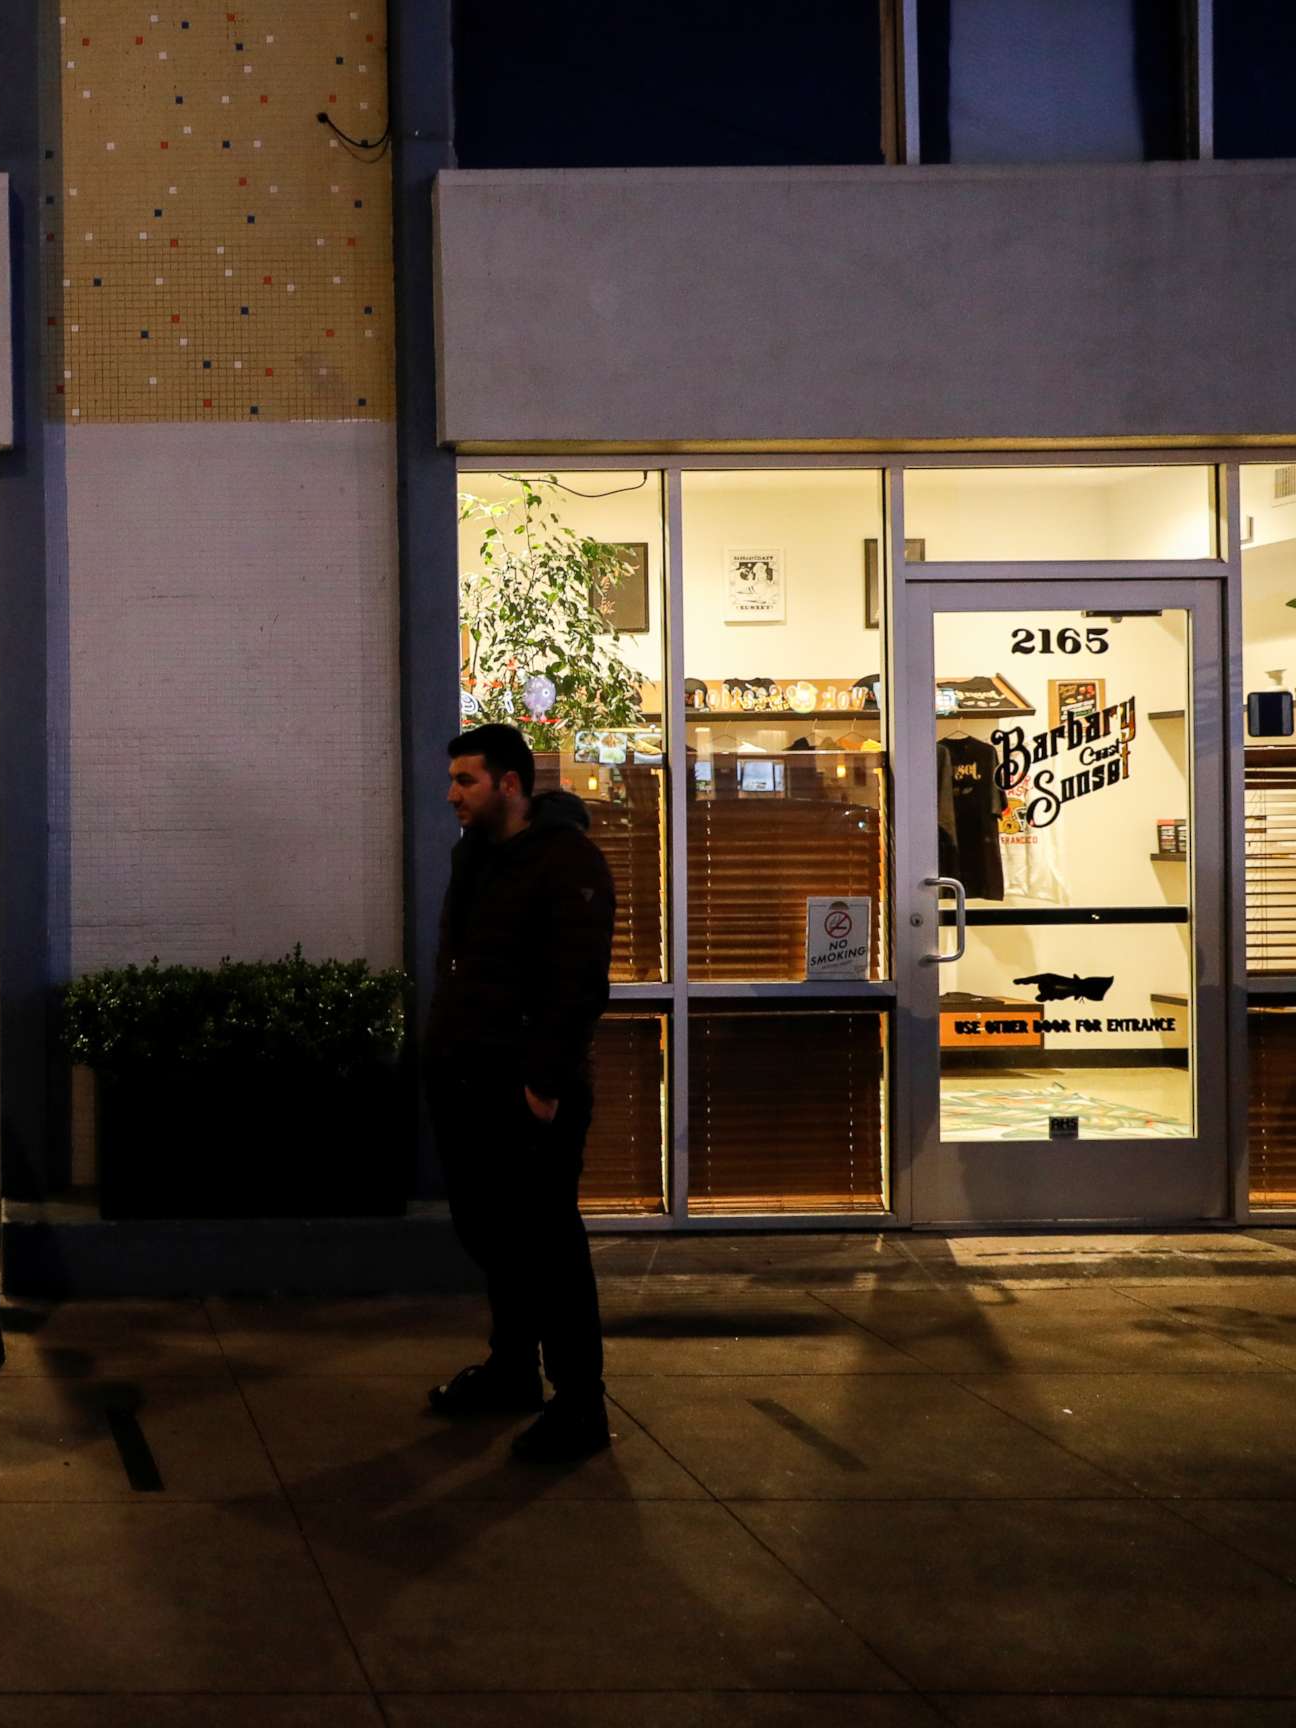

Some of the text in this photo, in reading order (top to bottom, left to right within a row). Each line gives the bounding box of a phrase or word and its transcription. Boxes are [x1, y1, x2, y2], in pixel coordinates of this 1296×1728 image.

[1011, 628, 1110, 655] 2165
[990, 695, 1136, 790] Barbary
[1026, 741, 1131, 829] Sunset
[810, 946, 867, 967] SMOKING
[829, 939, 848, 951] NO
[954, 1017, 1176, 1035] USE OTHER DOOR FOR ENTRANCE
